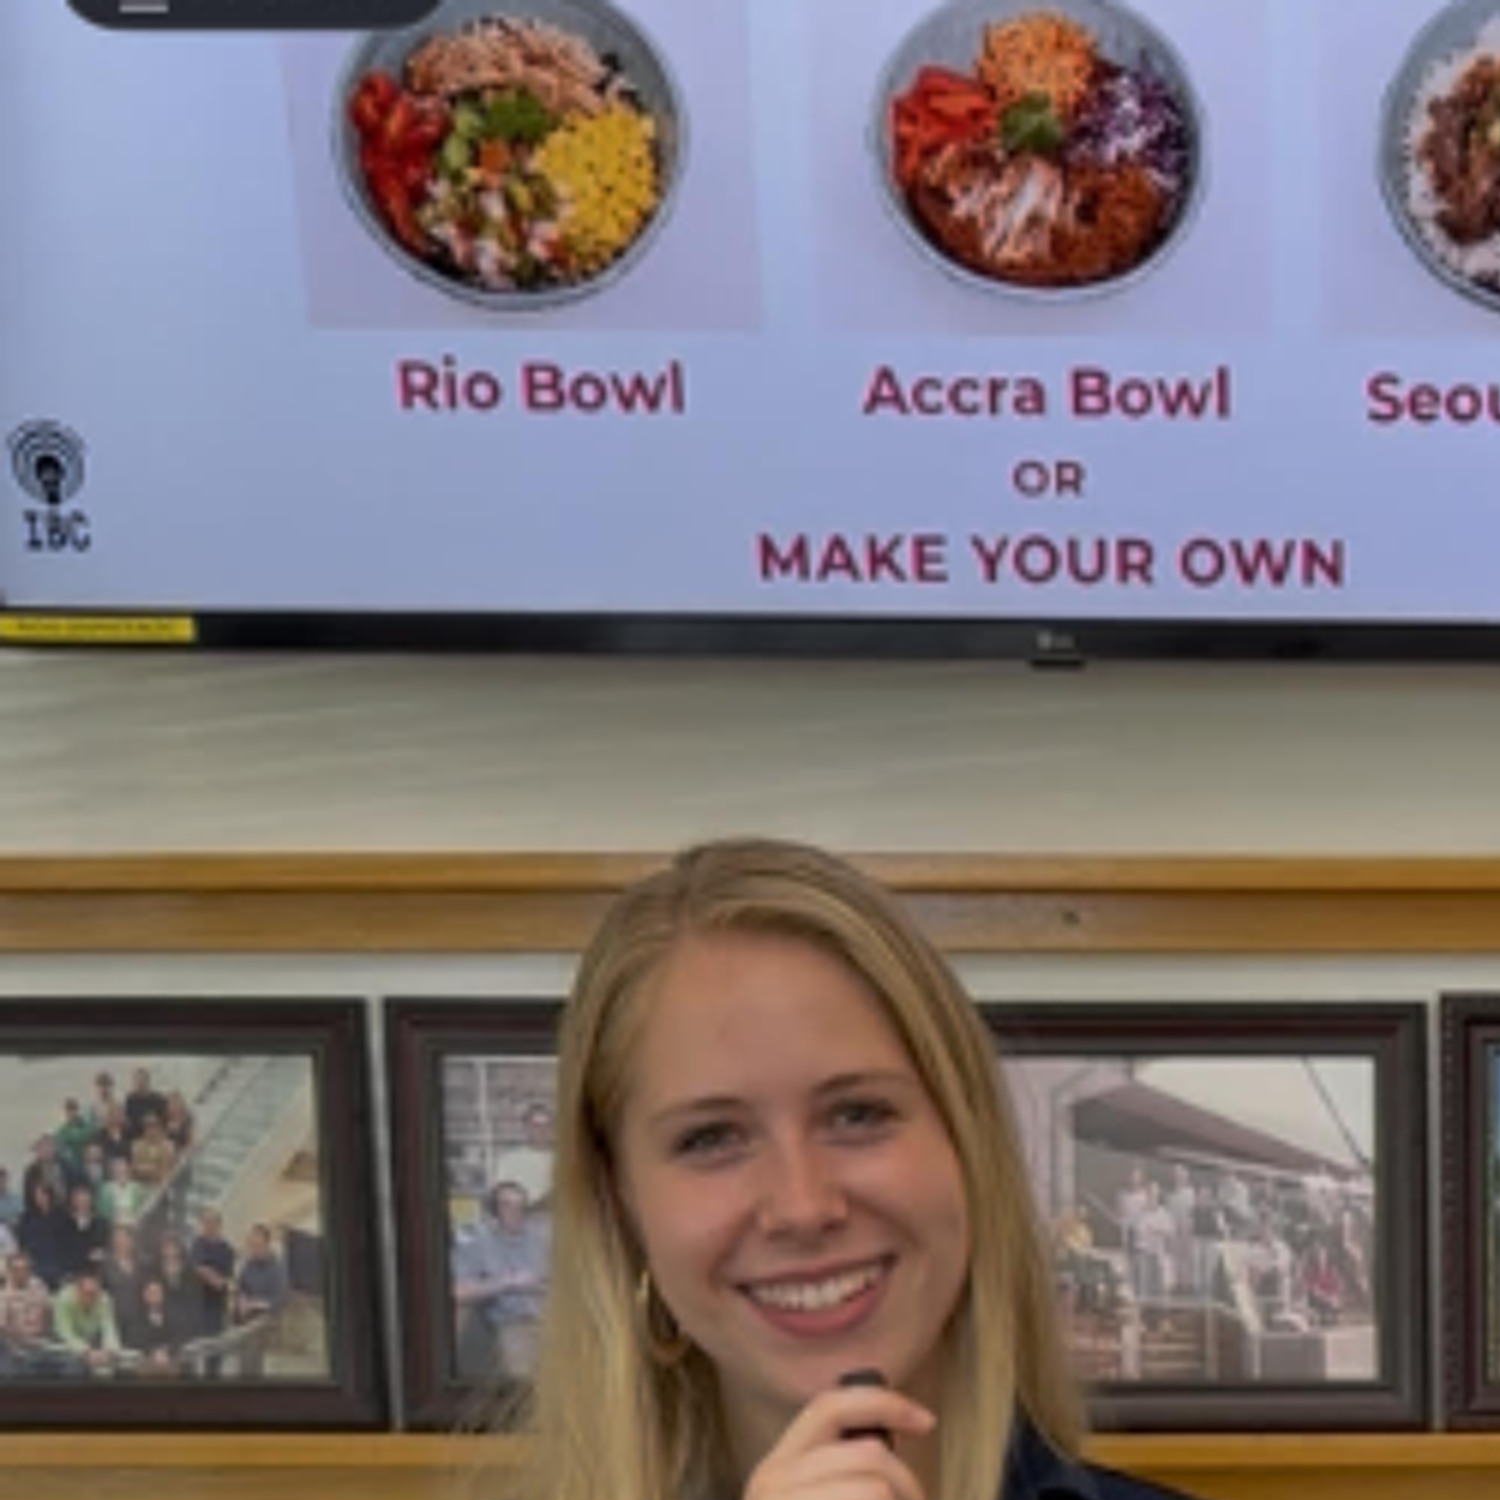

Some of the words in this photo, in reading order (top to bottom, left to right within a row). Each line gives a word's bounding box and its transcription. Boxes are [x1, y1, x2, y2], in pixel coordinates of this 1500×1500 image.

[397, 355, 503, 413] Rio
[521, 360, 685, 415] Bowl
[862, 365, 1047, 418] Accra
[1069, 365, 1231, 420] Bowl
[1012, 460, 1086, 498] OR
[23, 508, 92, 552] IBC
[757, 532, 949, 583] MAKE
[970, 534, 1155, 586] YOUR
[1179, 537, 1344, 588] OWN
